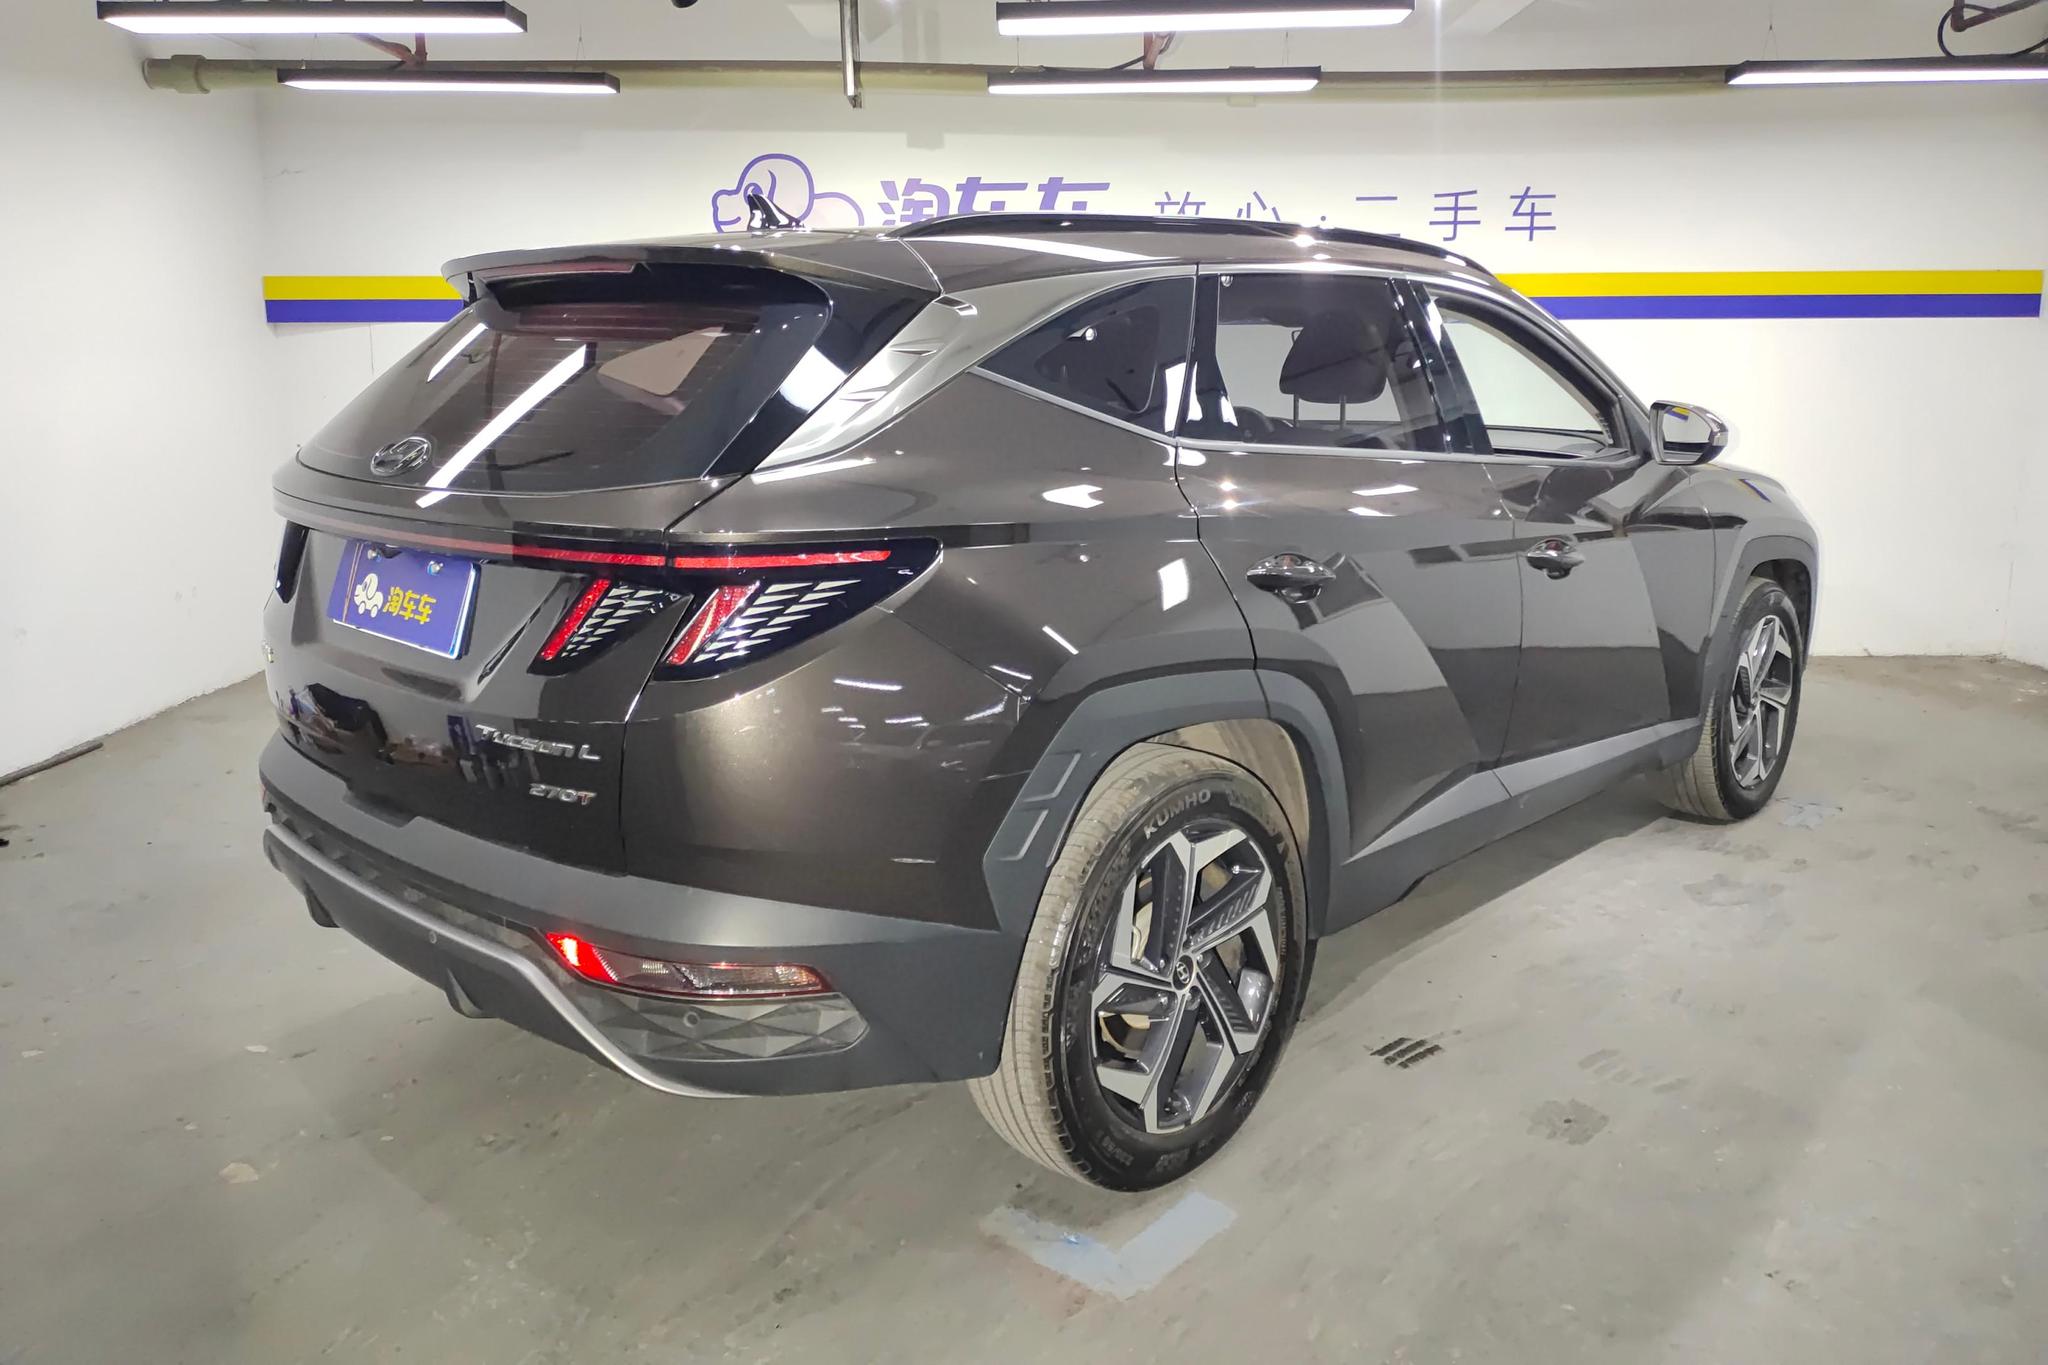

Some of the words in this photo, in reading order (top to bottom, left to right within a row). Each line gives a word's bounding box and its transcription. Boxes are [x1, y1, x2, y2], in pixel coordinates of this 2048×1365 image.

[383, 586, 436, 624] 淘车车
[578, 744, 601, 760] L
[529, 783, 597, 805] 270T
[1143, 789, 1211, 840] KUMHO
